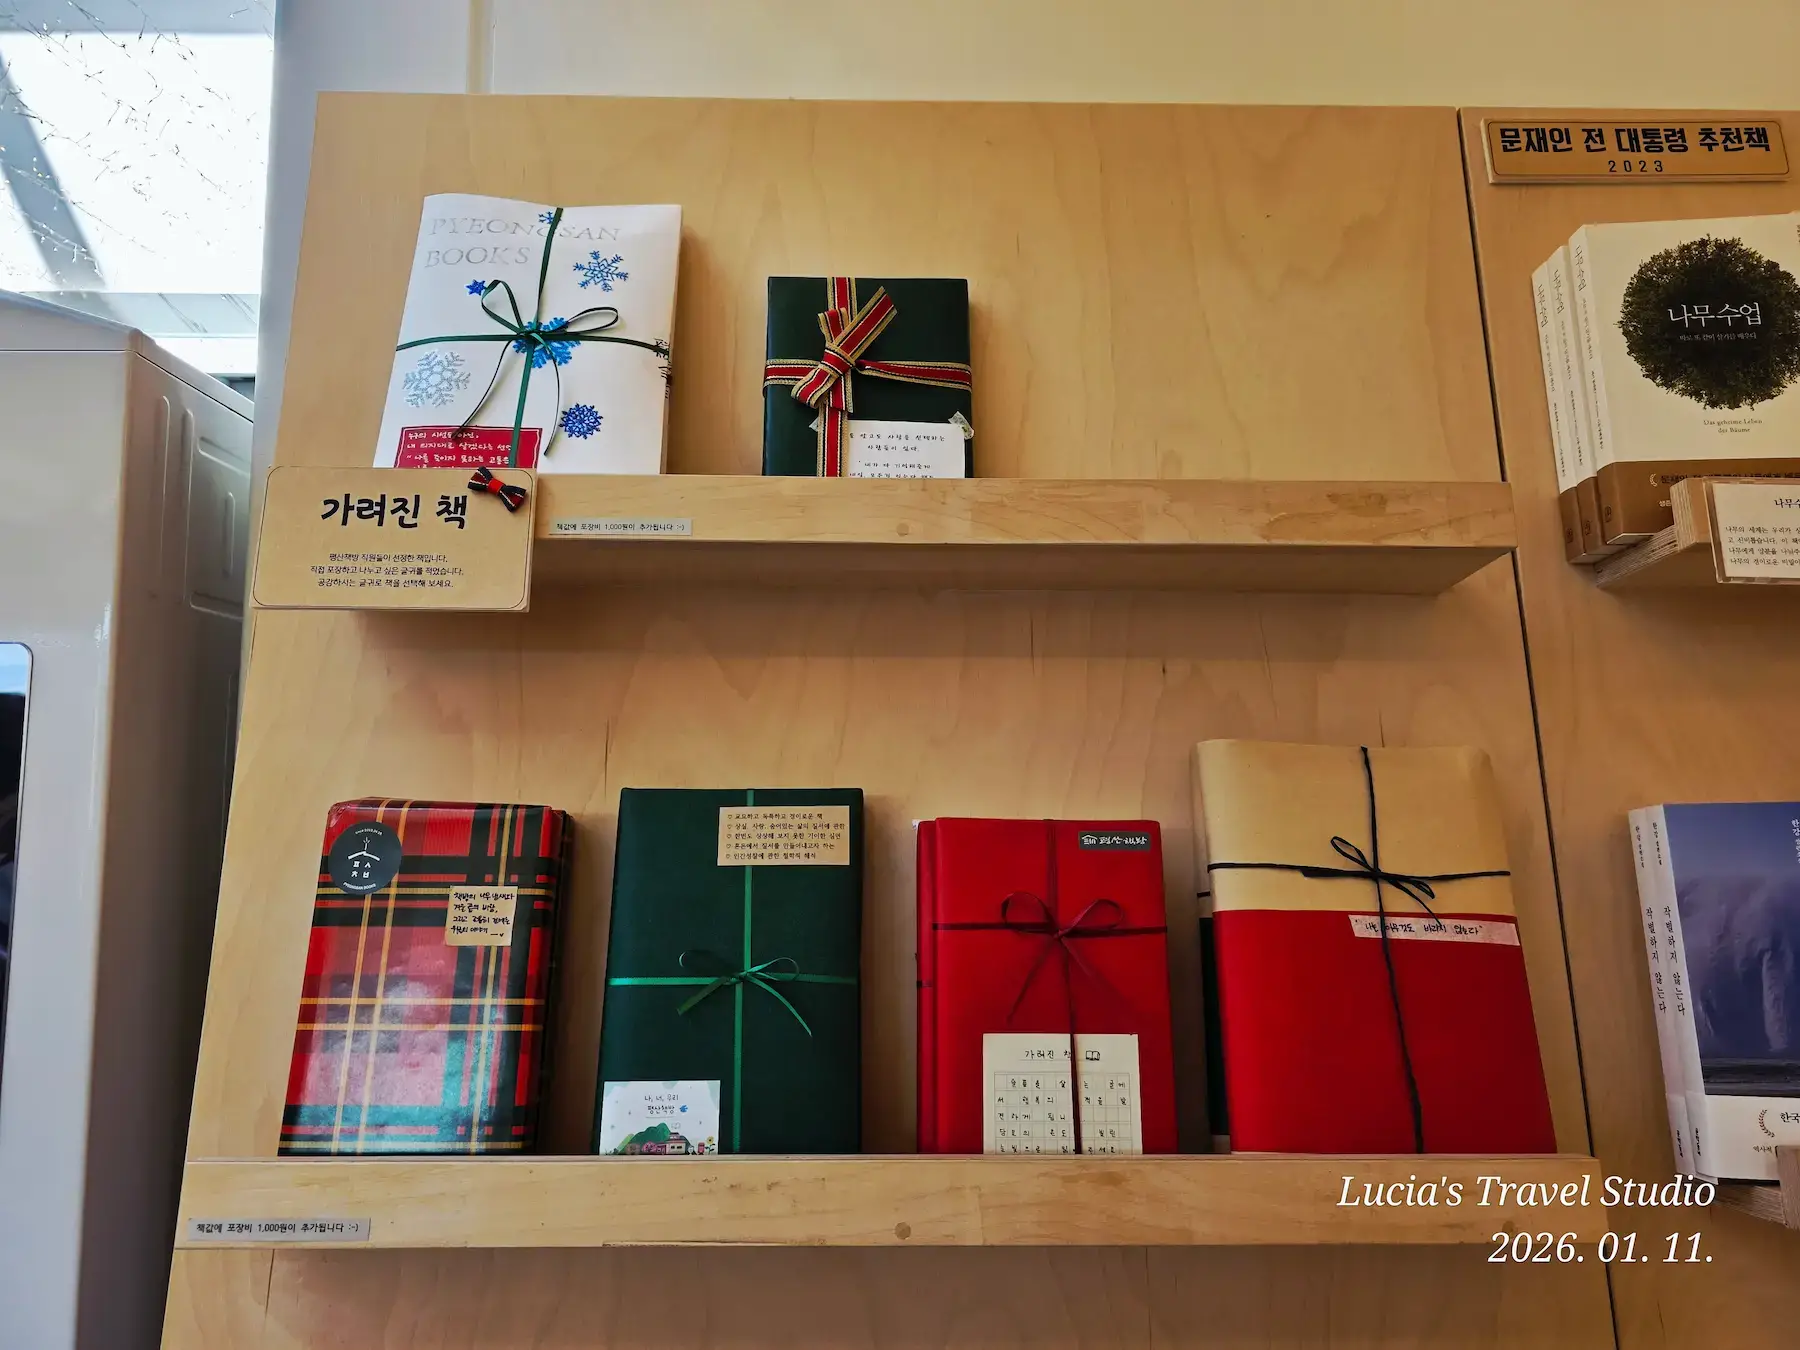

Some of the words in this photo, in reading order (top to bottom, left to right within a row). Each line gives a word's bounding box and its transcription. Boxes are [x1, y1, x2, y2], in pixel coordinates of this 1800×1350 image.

[1500, 127, 1573, 152] 문재인
[1581, 128, 1608, 152] 전
[1615, 128, 1689, 153] 대통령
[1698, 127, 1771, 152] 추천책
[1608, 160, 1664, 173] 2023
[424, 246, 530, 268] BOOKS
[321, 494, 420, 528] 가려진
[436, 495, 468, 529] 책
[556, 523, 577, 531] 책값에
[580, 523, 601, 531] 포장비
[604, 523, 635, 531] 1,000원이
[639, 523, 673, 531] 추가됩니다
[1725, 525, 1745, 533] 나무의
[1749, 526, 1769, 534] 세계는
[1772, 526, 1792, 534] 우리가
[1737, 536, 1778, 545] 신비롭습니다.
[1728, 546, 1755, 555] 나무에게
[329, 553, 359, 562] 평산책방
[361, 553, 391, 562] 직원들이
[393, 553, 414, 562] 선정한
[416, 554, 448, 563] 책입니다.
[1730, 557, 1750, 565] 나무의
[1753, 558, 1780, 566] 경이로운
[310, 565, 325, 574] 직접
[327, 566, 357, 575] 포장하고
[359, 566, 382, 575] 나누고
[384, 567, 399, 575] 싶은
[401, 567, 423, 576] 글귀를
[425, 567, 464, 576] 적었습니다.
[317, 578, 357, 587] 공감하시는
[359, 579, 382, 587] 글귀로
[384, 579, 400, 588] 책을
[402, 579, 426, 588] 선택해
[428, 580, 454, 588] 보세요.
[453, 892, 476, 901] 책방의
[1645, 907, 1660, 963] 작별하지
[1654, 972, 1667, 1014] 않는다
[1663, 906, 1678, 963] 작별하지
[1672, 972, 1686, 1016] 않는다
[1025, 1049, 1054, 1060] 가려진
[647, 1105, 675, 1115] 평산책방
[196, 1223, 223, 1233] 책값에
[227, 1223, 253, 1233] 포장비
[257, 1223, 296, 1233] 1,000원이
[300, 1223, 344, 1233] 추가됩니다
